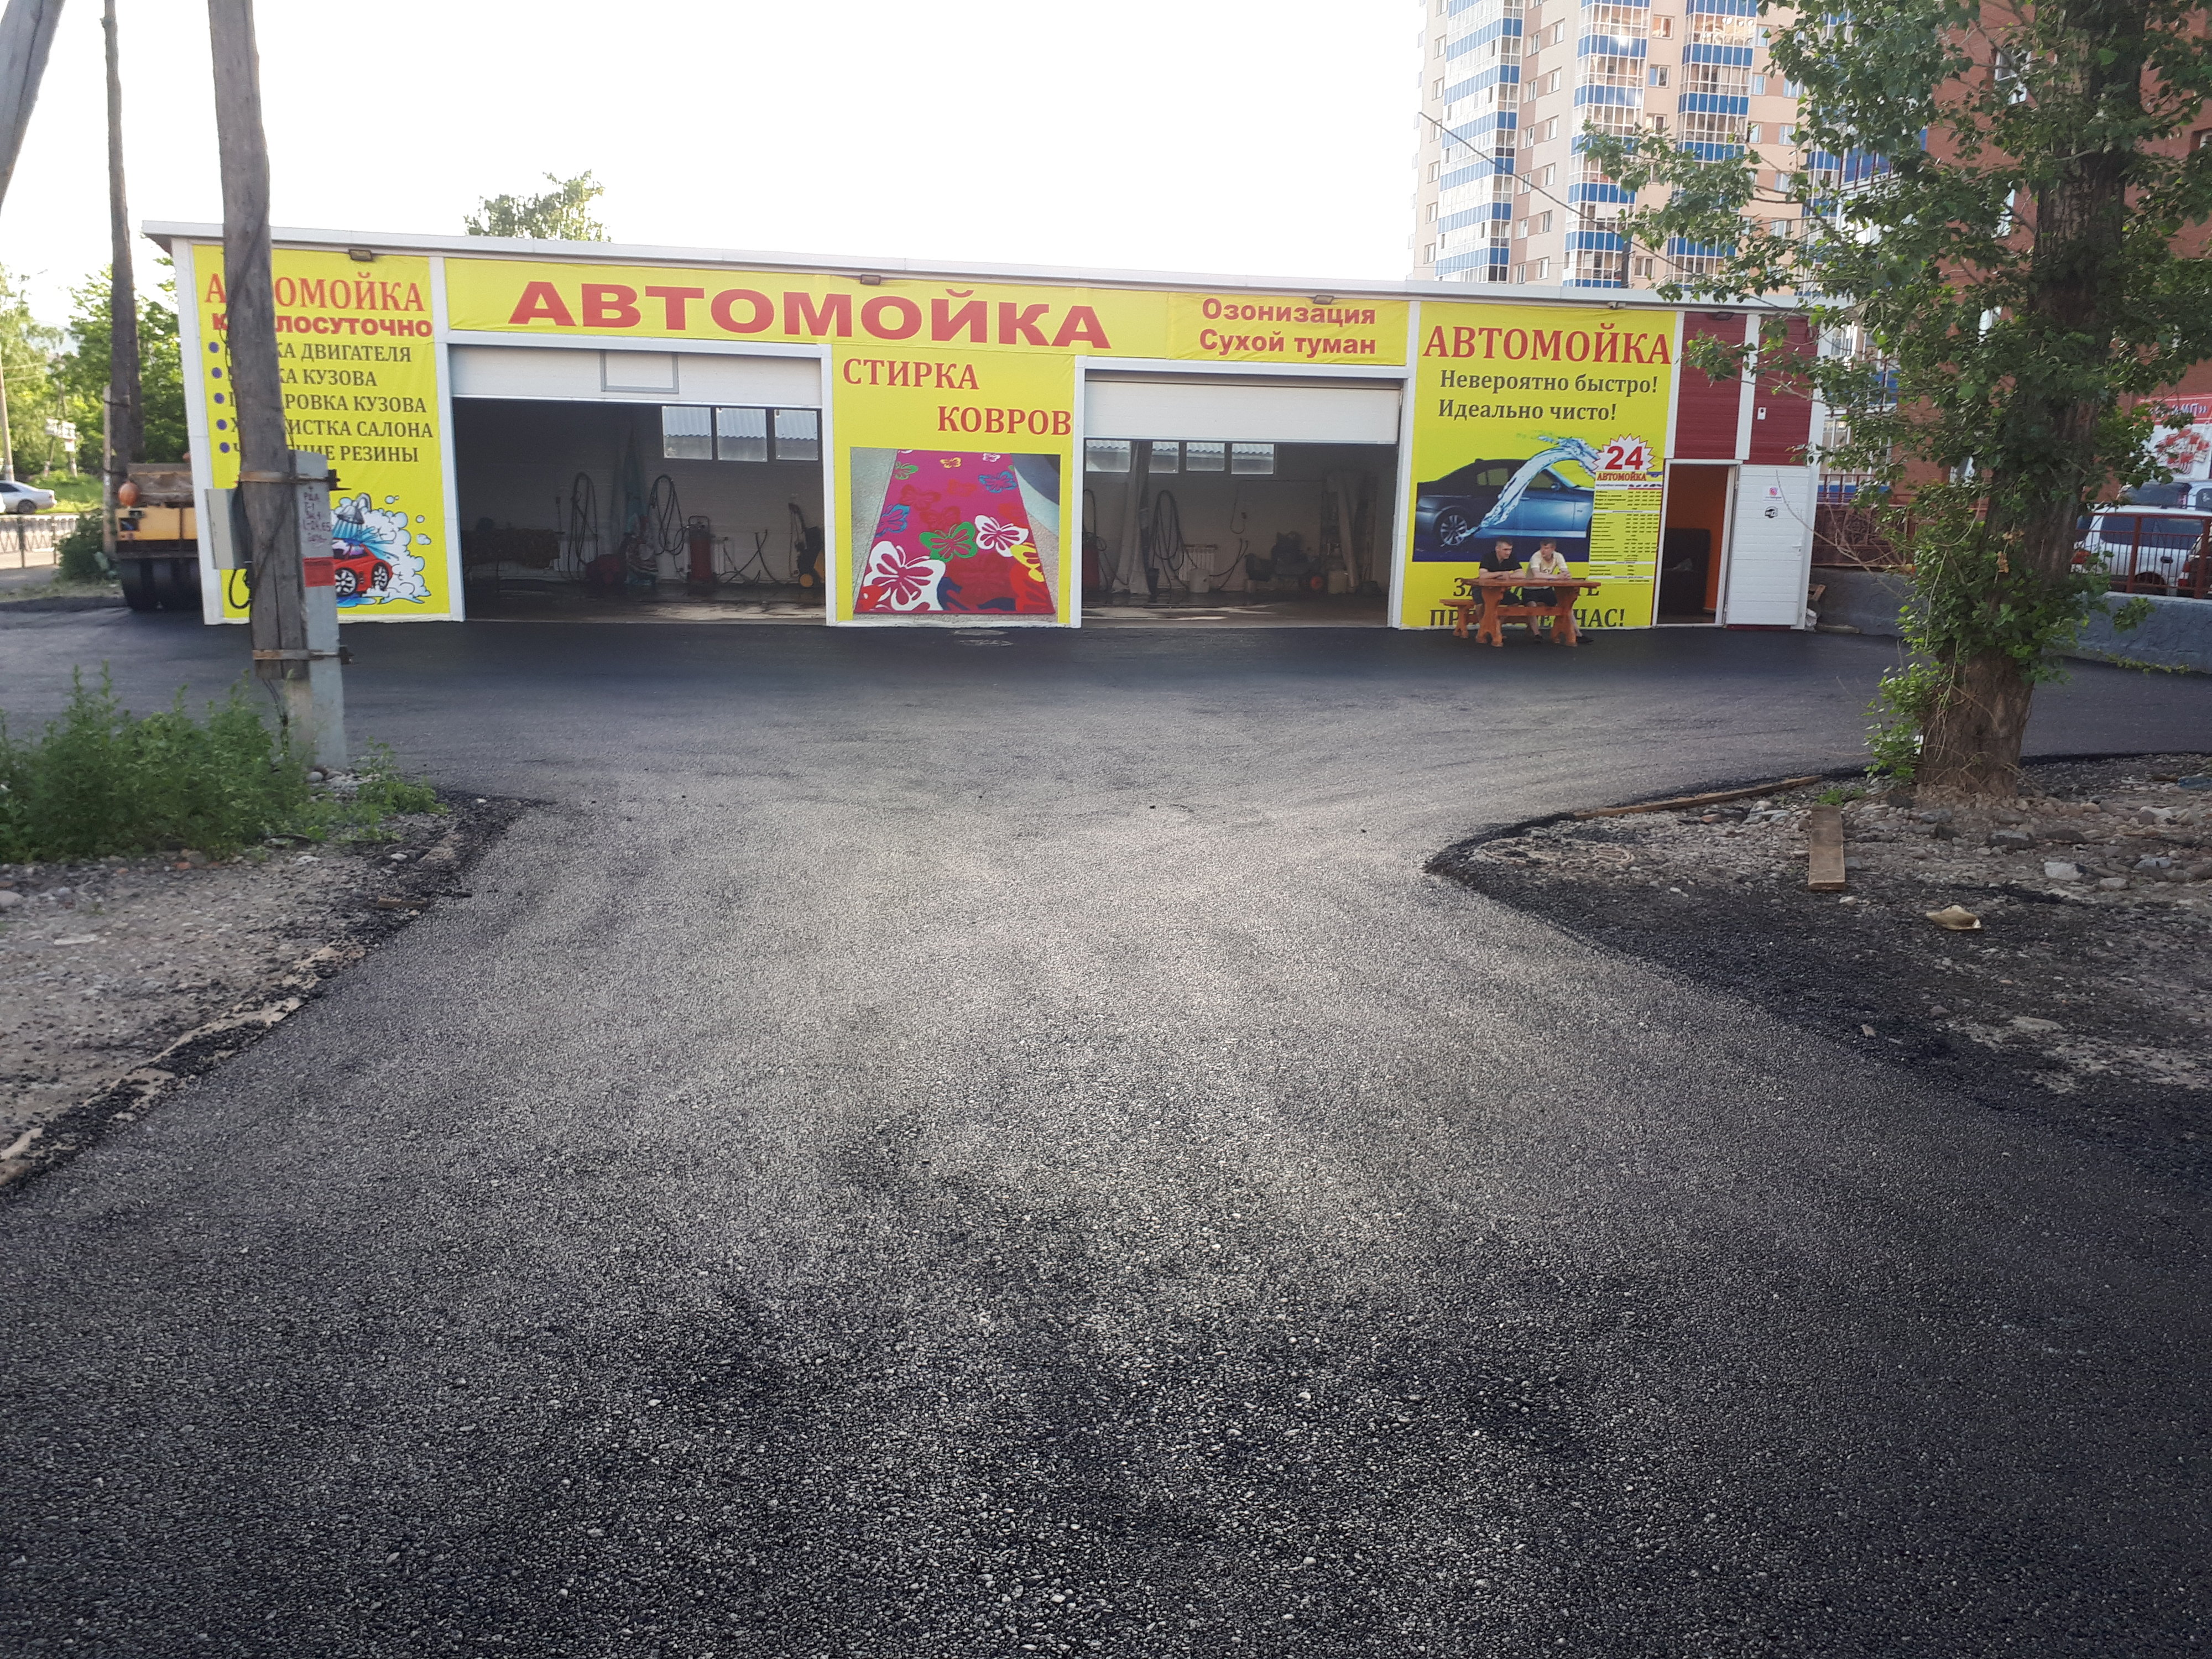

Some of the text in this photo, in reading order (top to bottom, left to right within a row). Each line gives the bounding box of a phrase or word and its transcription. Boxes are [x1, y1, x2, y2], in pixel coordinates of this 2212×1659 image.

[205, 272, 425, 311] АОМОЙКА
[508, 280, 1112, 349] АВТОМОЙКА
[1202, 298, 1376, 328] Озонизация
[301, 343, 411, 363] ДВИГАТЕЛЯ
[1199, 328, 1376, 359] Сухой туман
[1423, 322, 1672, 364] АВТОМОЙКА
[303, 368, 378, 387] КУЗОВА
[842, 357, 980, 390] СТИРКА
[1440, 369, 1658, 398] Невероятно быстро!
[353, 395, 427, 413] КУЗОВА
[1438, 399, 1617, 421] Идеально чисто!
[356, 420, 434, 438] САЛОНА
[937, 405, 1072, 436] КОВРОВ
[340, 445, 419, 463] РЕЗИНЫ
[1605, 446, 1644, 470] 24
[1597, 471, 1646, 481] АВТОМОЙКА
